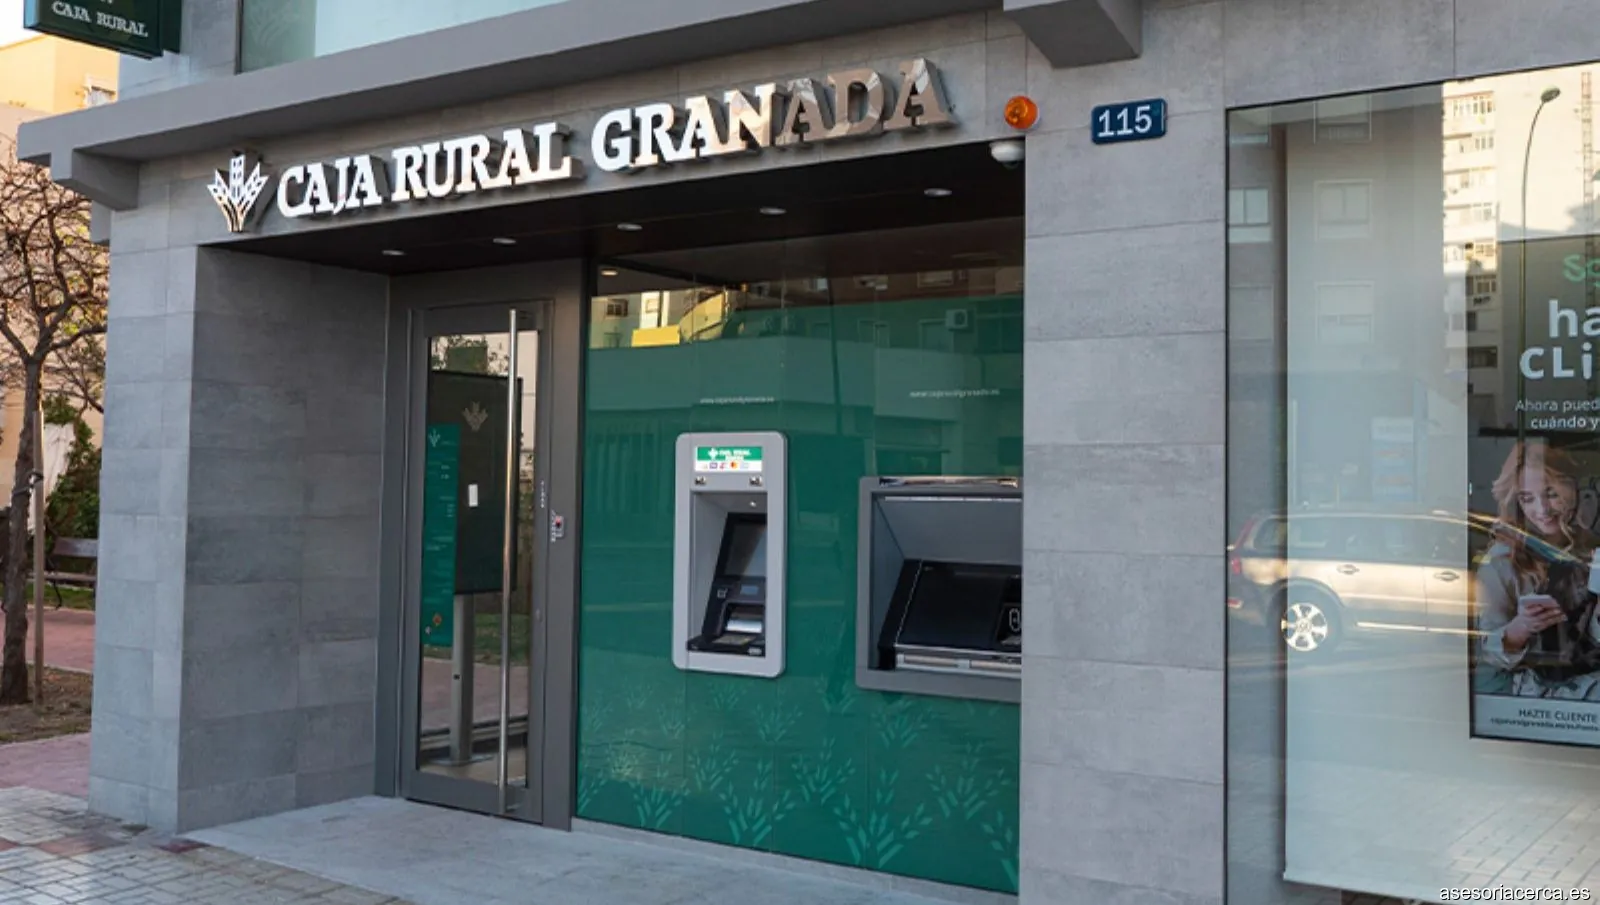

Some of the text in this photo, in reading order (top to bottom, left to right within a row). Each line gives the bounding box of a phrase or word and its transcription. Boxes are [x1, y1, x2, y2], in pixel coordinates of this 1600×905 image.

[52, 1, 149, 37] CAJA RURAL
[1098, 104, 1153, 137] 115
[277, 57, 950, 218] CAJA RURAL GRANADA
[1515, 397, 1559, 412] Ahora
[1519, 708, 1598, 723] HAZTE CLIENTE
